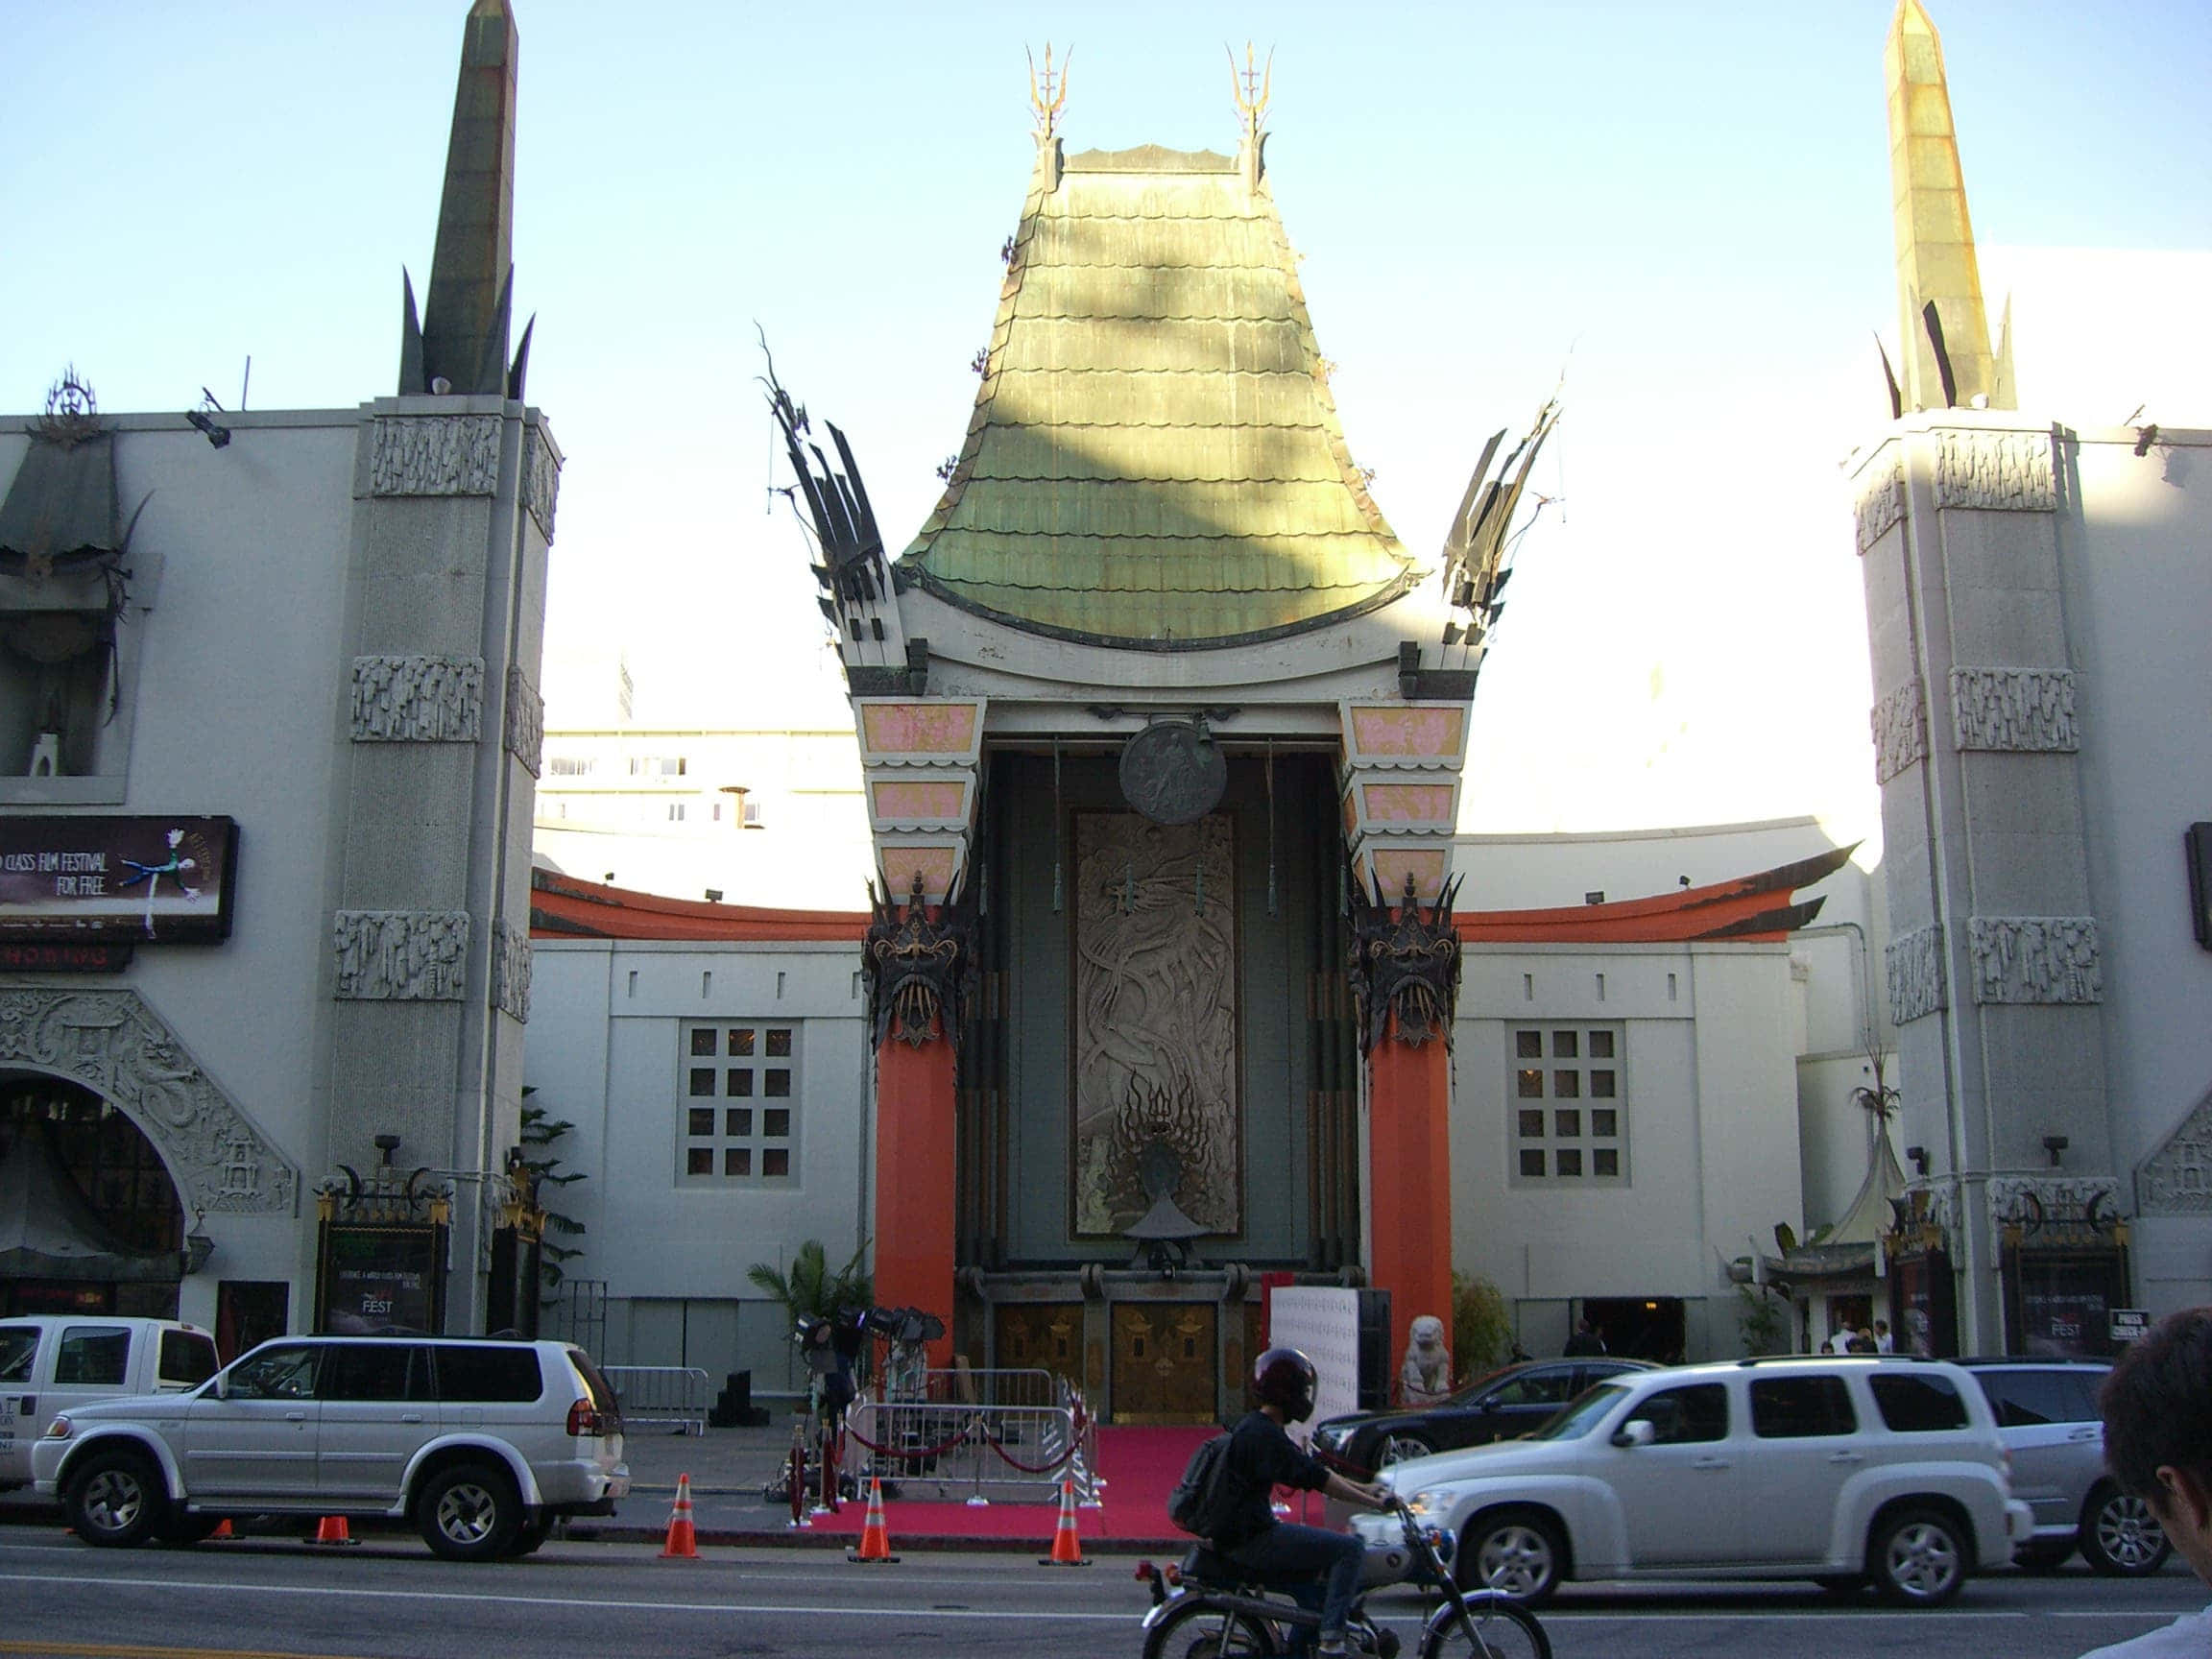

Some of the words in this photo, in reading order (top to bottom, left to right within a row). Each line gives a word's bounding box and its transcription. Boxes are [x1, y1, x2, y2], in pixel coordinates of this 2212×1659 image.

[5, 854, 36, 872] CLASS
[38, 853, 59, 872] FILM
[61, 852, 109, 873] FESTIVAL
[57, 875, 77, 896] FOR
[79, 875, 108, 896] FREE
[362, 1300, 393, 1313] FEST
[2051, 1324, 2082, 1337] FEST
